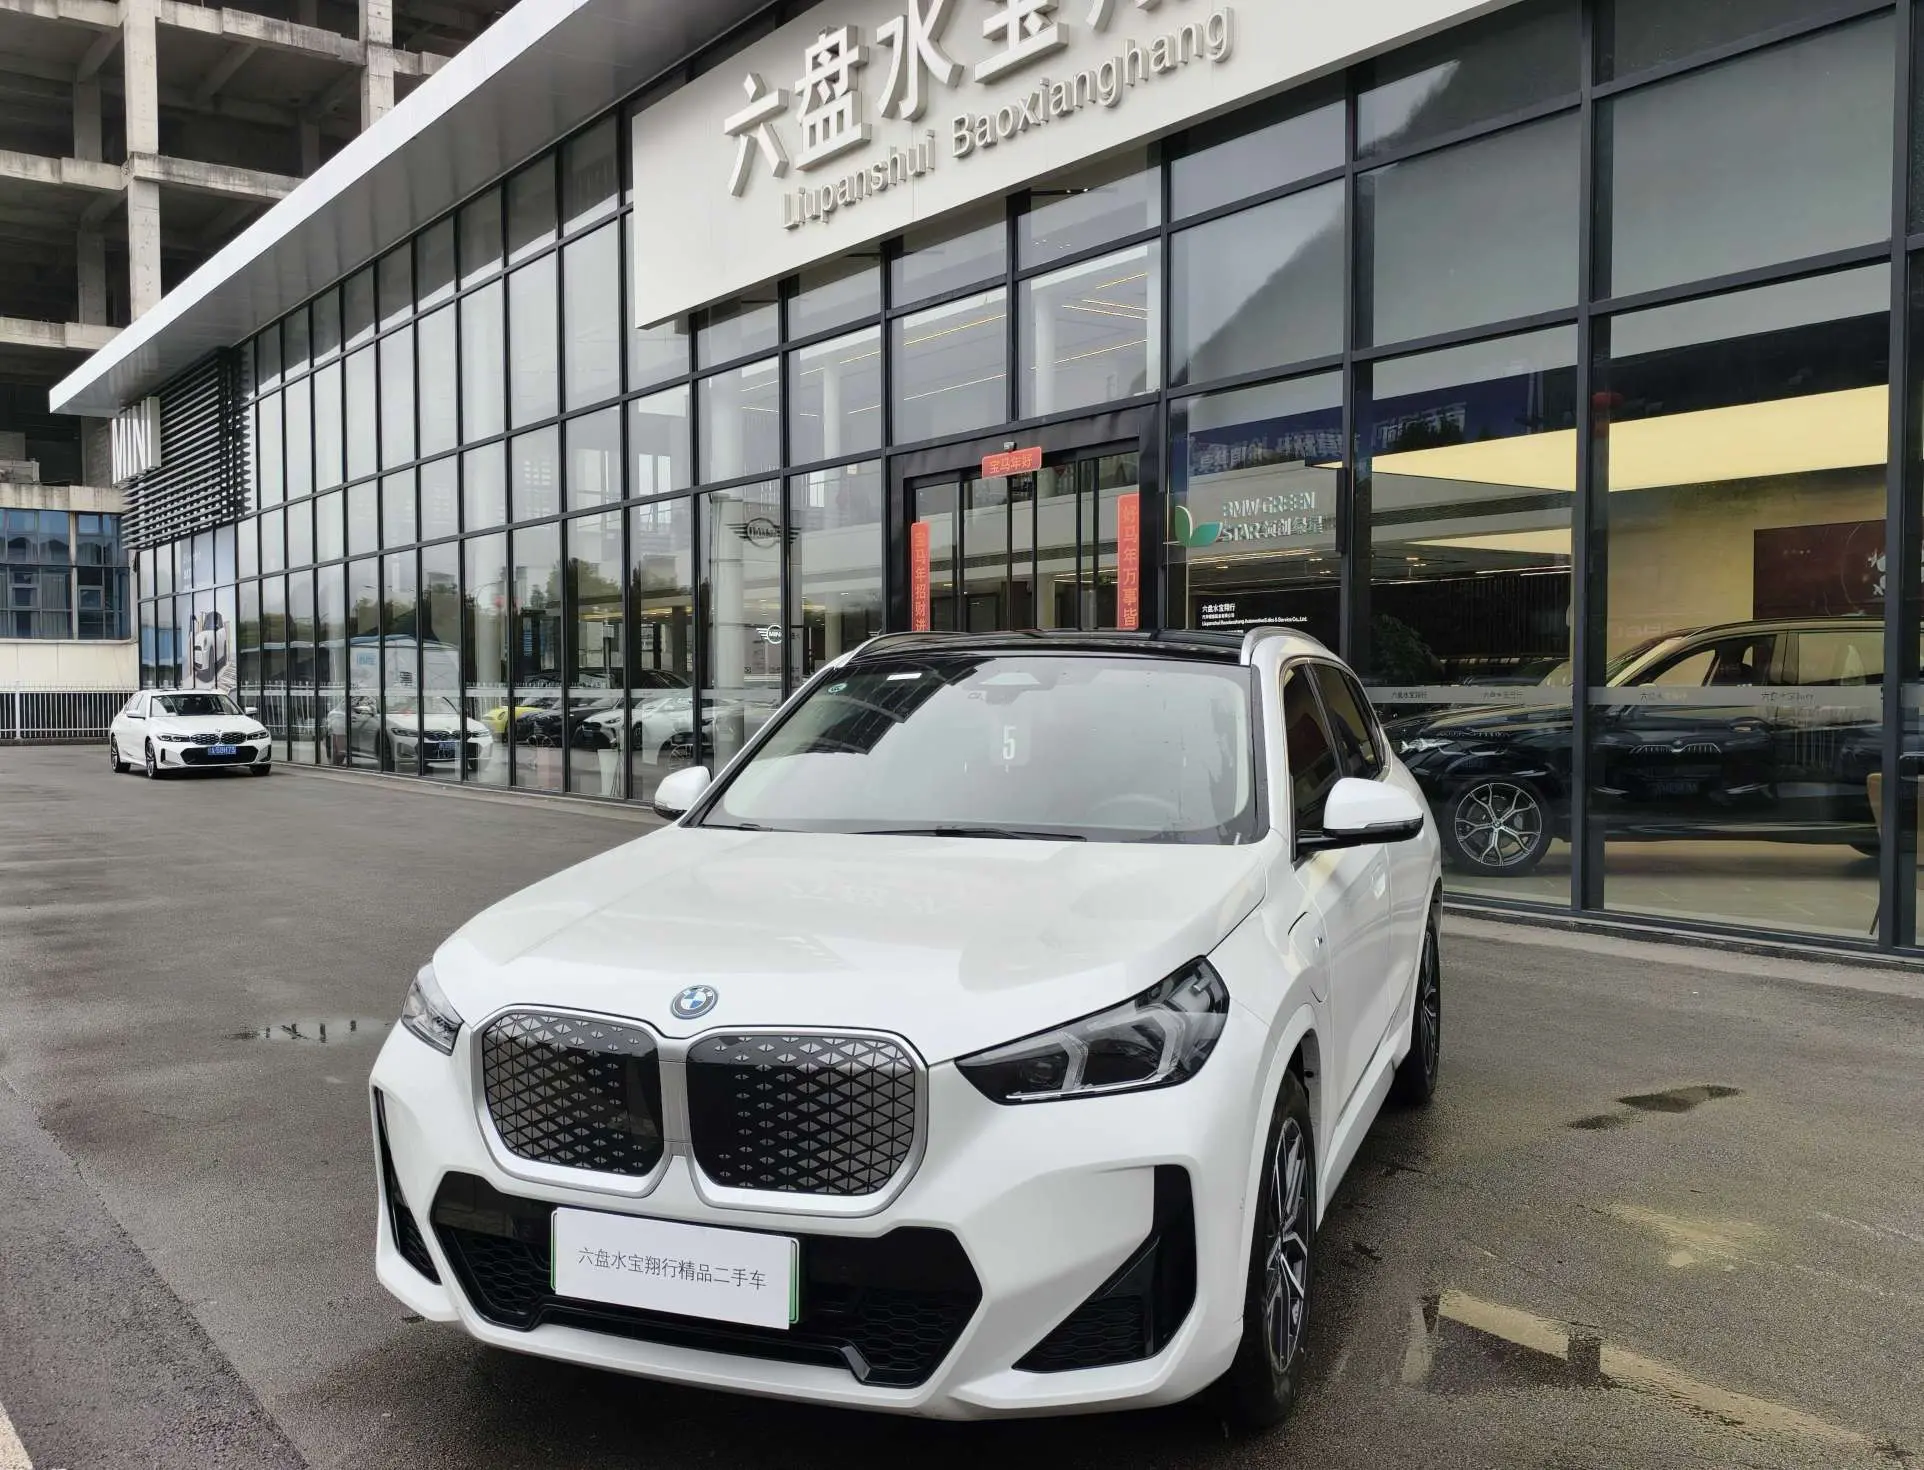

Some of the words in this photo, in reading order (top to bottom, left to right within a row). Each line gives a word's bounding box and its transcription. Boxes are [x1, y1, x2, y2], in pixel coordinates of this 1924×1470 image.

[724, 0, 1165, 197] 六盘水宝
[781, 129, 936, 230] Liupanshui
[952, 6, 1235, 159] Baoxianghang
[112, 397, 152, 485] MINI
[1223, 497, 1260, 517] BMW
[1262, 491, 1316, 514] GREEN
[1222, 520, 1261, 541] STAR
[1002, 725, 1017, 760] 5
[578, 1247, 767, 1291] 六盘水宝翔行精品二手车
